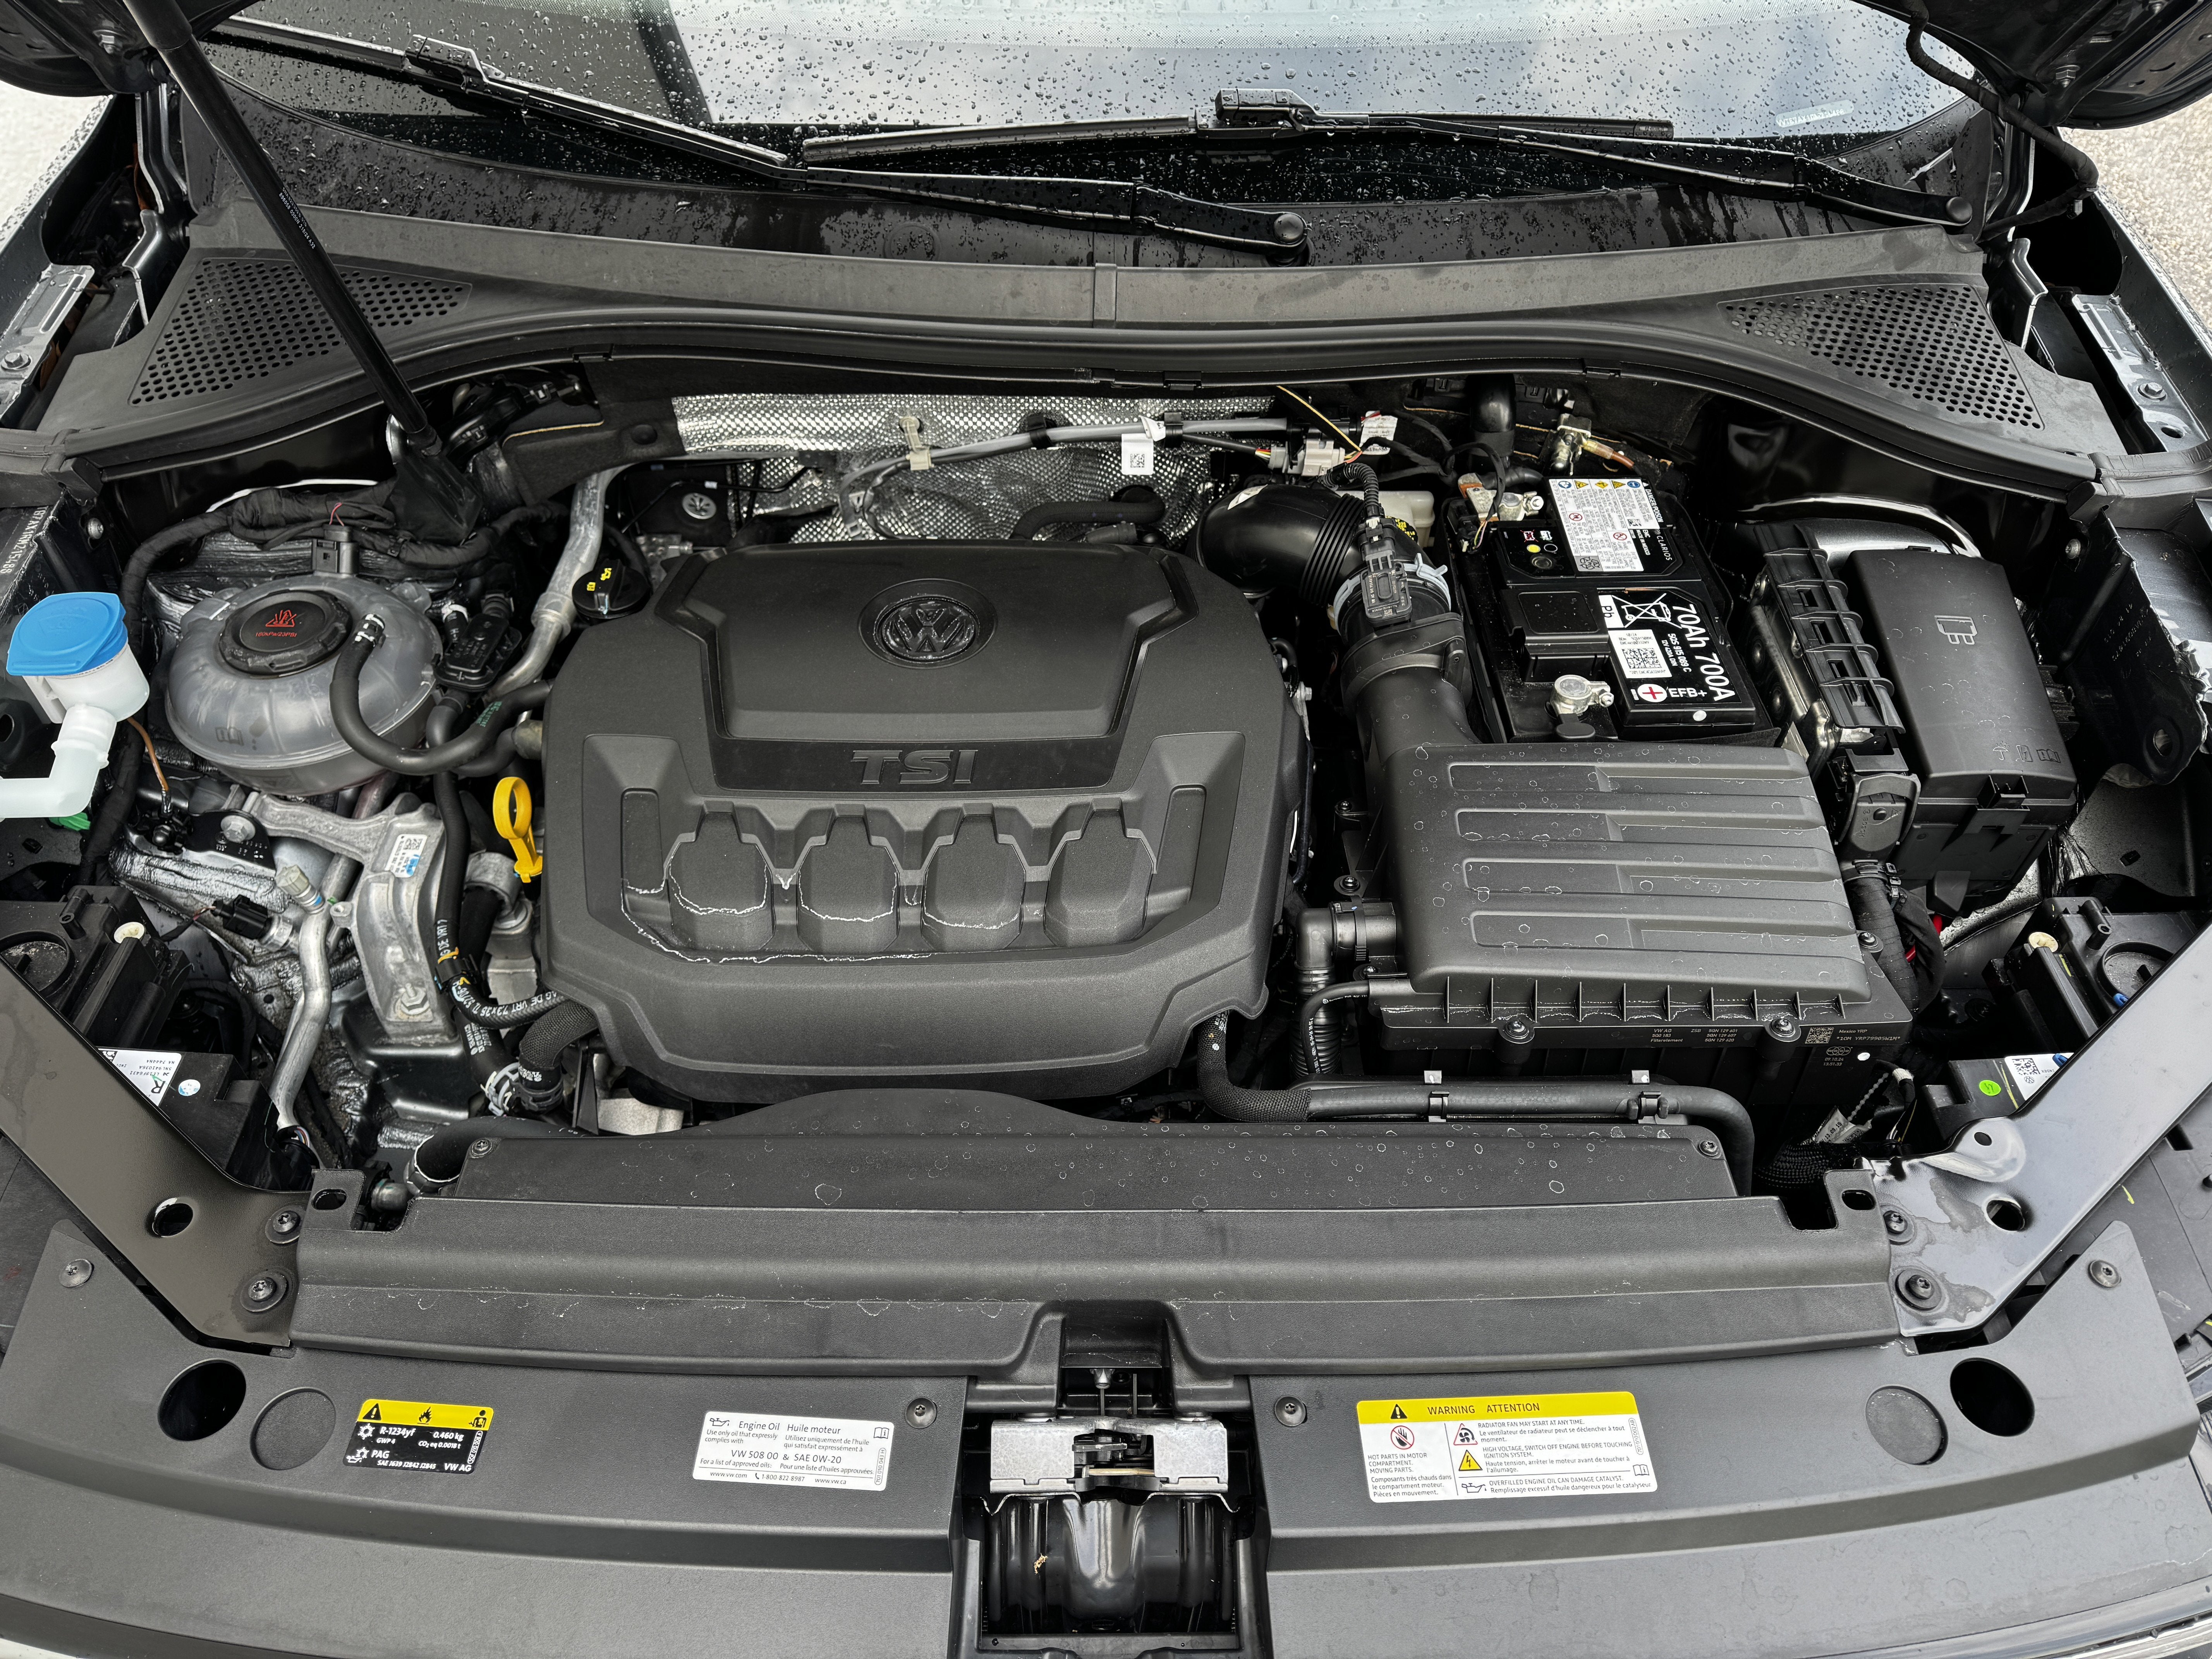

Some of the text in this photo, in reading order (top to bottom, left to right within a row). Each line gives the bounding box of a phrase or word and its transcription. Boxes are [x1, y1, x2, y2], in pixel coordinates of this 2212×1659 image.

[1642, 543, 1650, 555] MEXICO
[1657, 536, 1672, 560] CLARIOS
[1601, 606, 1613, 618] Pb
[1673, 646, 1684, 656] 915
[1673, 604, 1735, 701] 70Ah 700A
[1668, 688, 1707, 697] EFB+
[850, 749, 978, 785] TSI
[1858, 817, 1868, 838] BOSCH
[151, 1081, 165, 1094] R
[1427, 1403, 1540, 1415] WARNING ATTENTION
[739, 1421, 766, 1431] Engine
[787, 1424, 808, 1432] Huile
[380, 1426, 464, 1441] R-1234yf 0.460 kg
[371, 1450, 389, 1458] PAG
[732, 1449, 747, 1458] VW
[748, 1451, 764, 1459] 508
[794, 1454, 811, 1462] SAE
[812, 1455, 842, 1463] 0W-20
